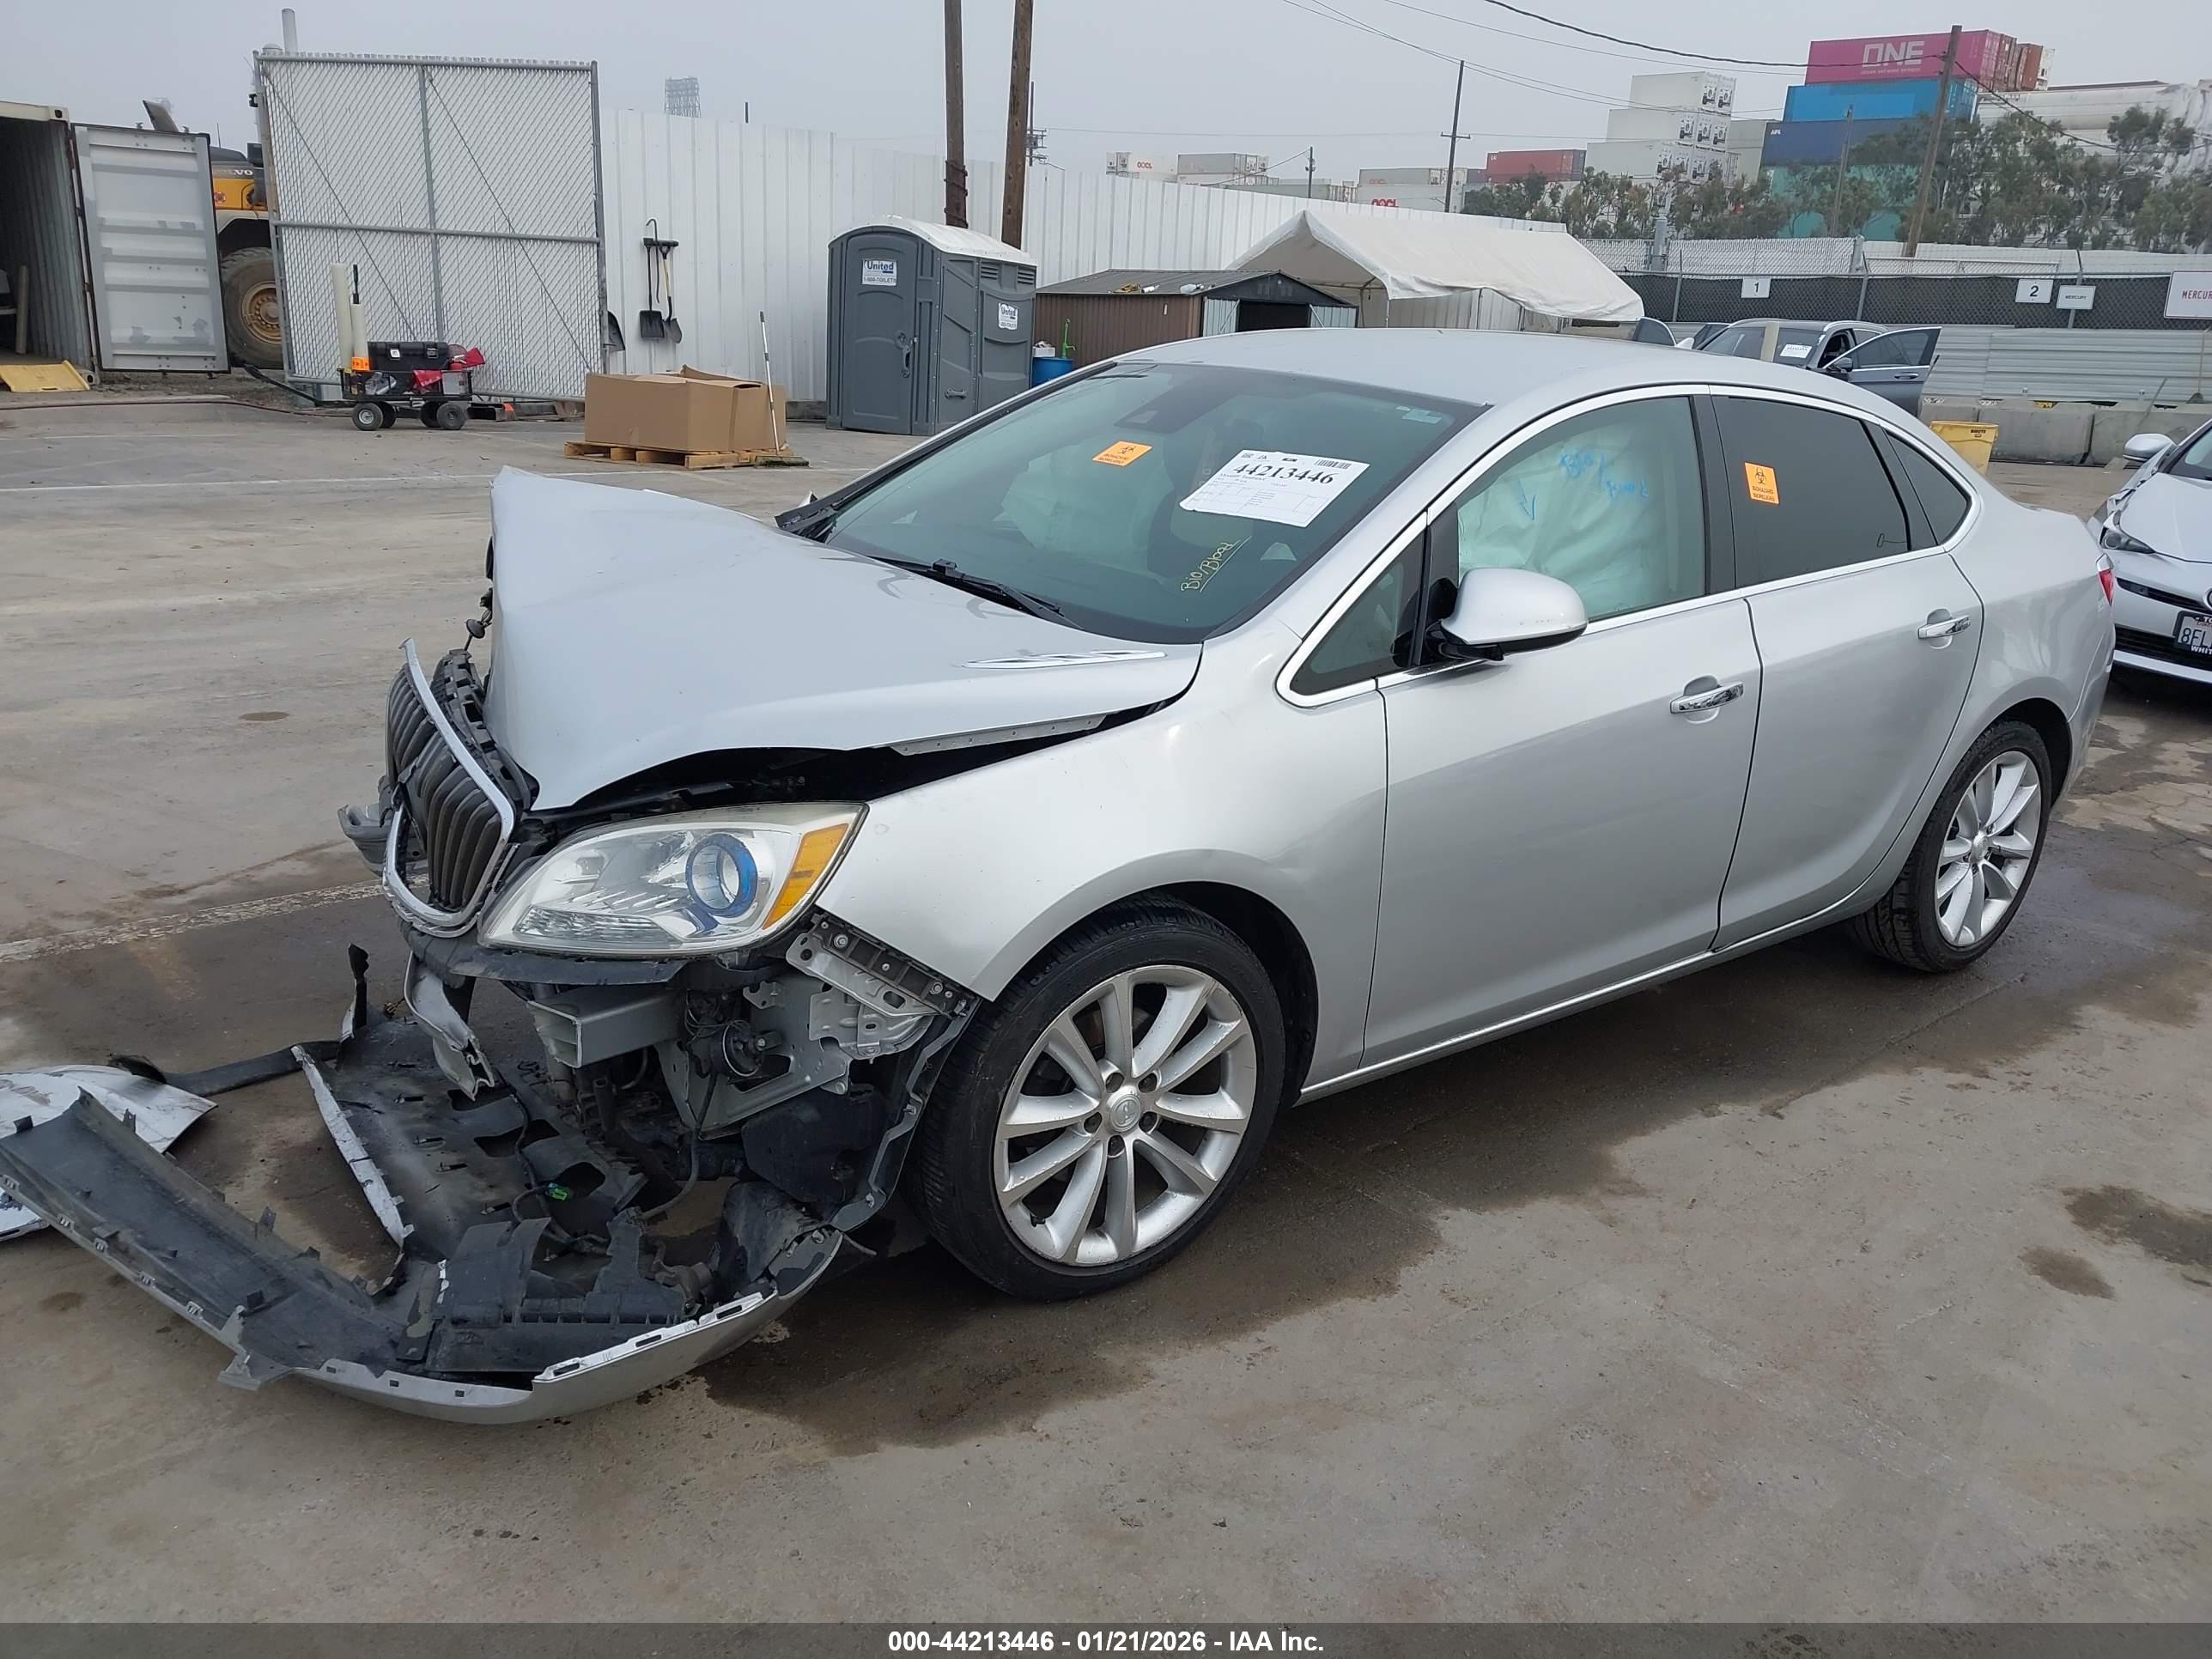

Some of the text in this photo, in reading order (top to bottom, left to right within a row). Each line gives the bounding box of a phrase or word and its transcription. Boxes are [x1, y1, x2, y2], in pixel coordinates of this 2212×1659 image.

[1862, 40, 1924, 68] ONE
[1137, 161, 1152, 169] OOCL
[867, 260, 894, 270] United
[1754, 282, 1759, 293] 1
[2029, 285, 2039, 297] 2
[1233, 463, 1340, 484] 44213446
